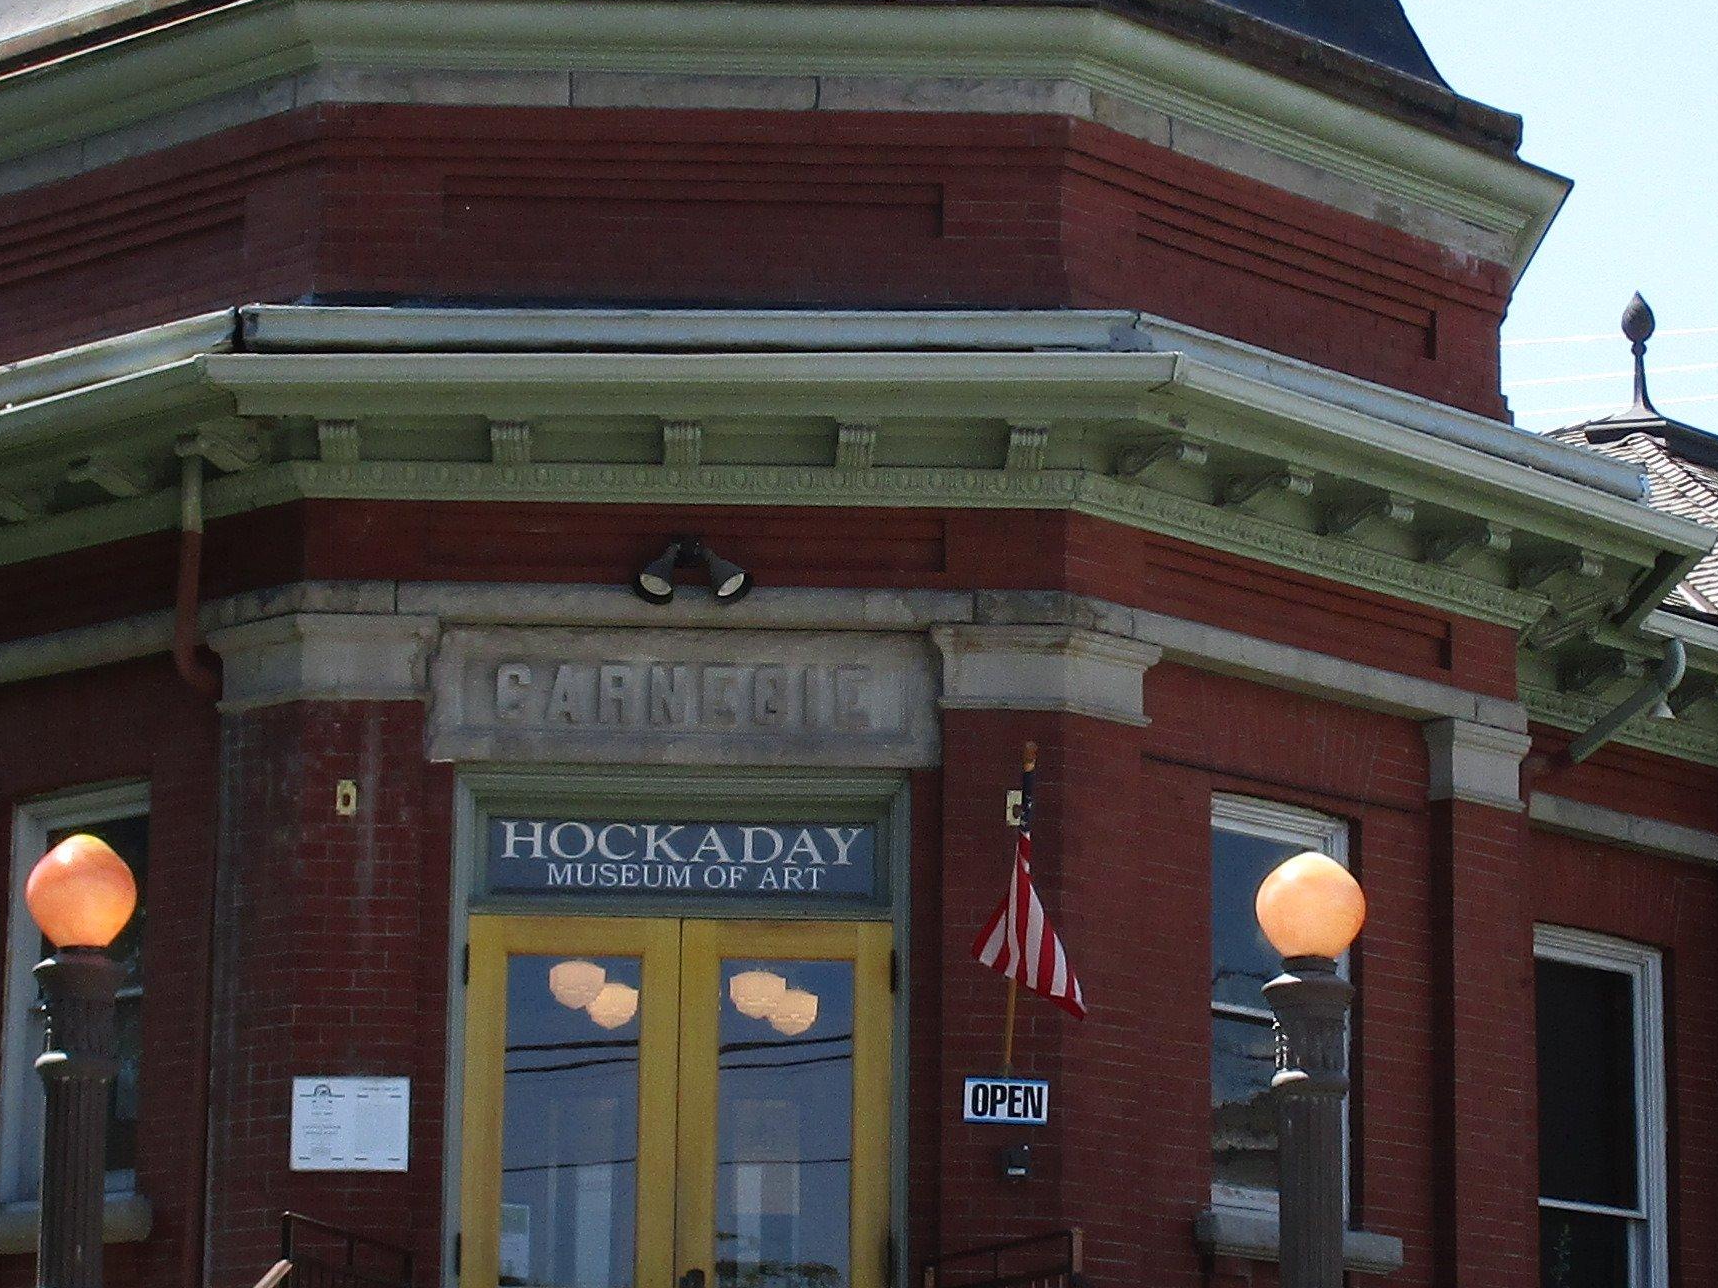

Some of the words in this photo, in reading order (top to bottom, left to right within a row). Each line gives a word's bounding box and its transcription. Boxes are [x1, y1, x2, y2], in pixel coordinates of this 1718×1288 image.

[494, 661, 875, 729] CARNEGIE
[500, 821, 864, 866] HOCKADAY
[546, 863, 691, 888] MUSEUM
[703, 865, 747, 889] OF
[758, 866, 826, 891] ART
[971, 1083, 1043, 1118] OPEN
